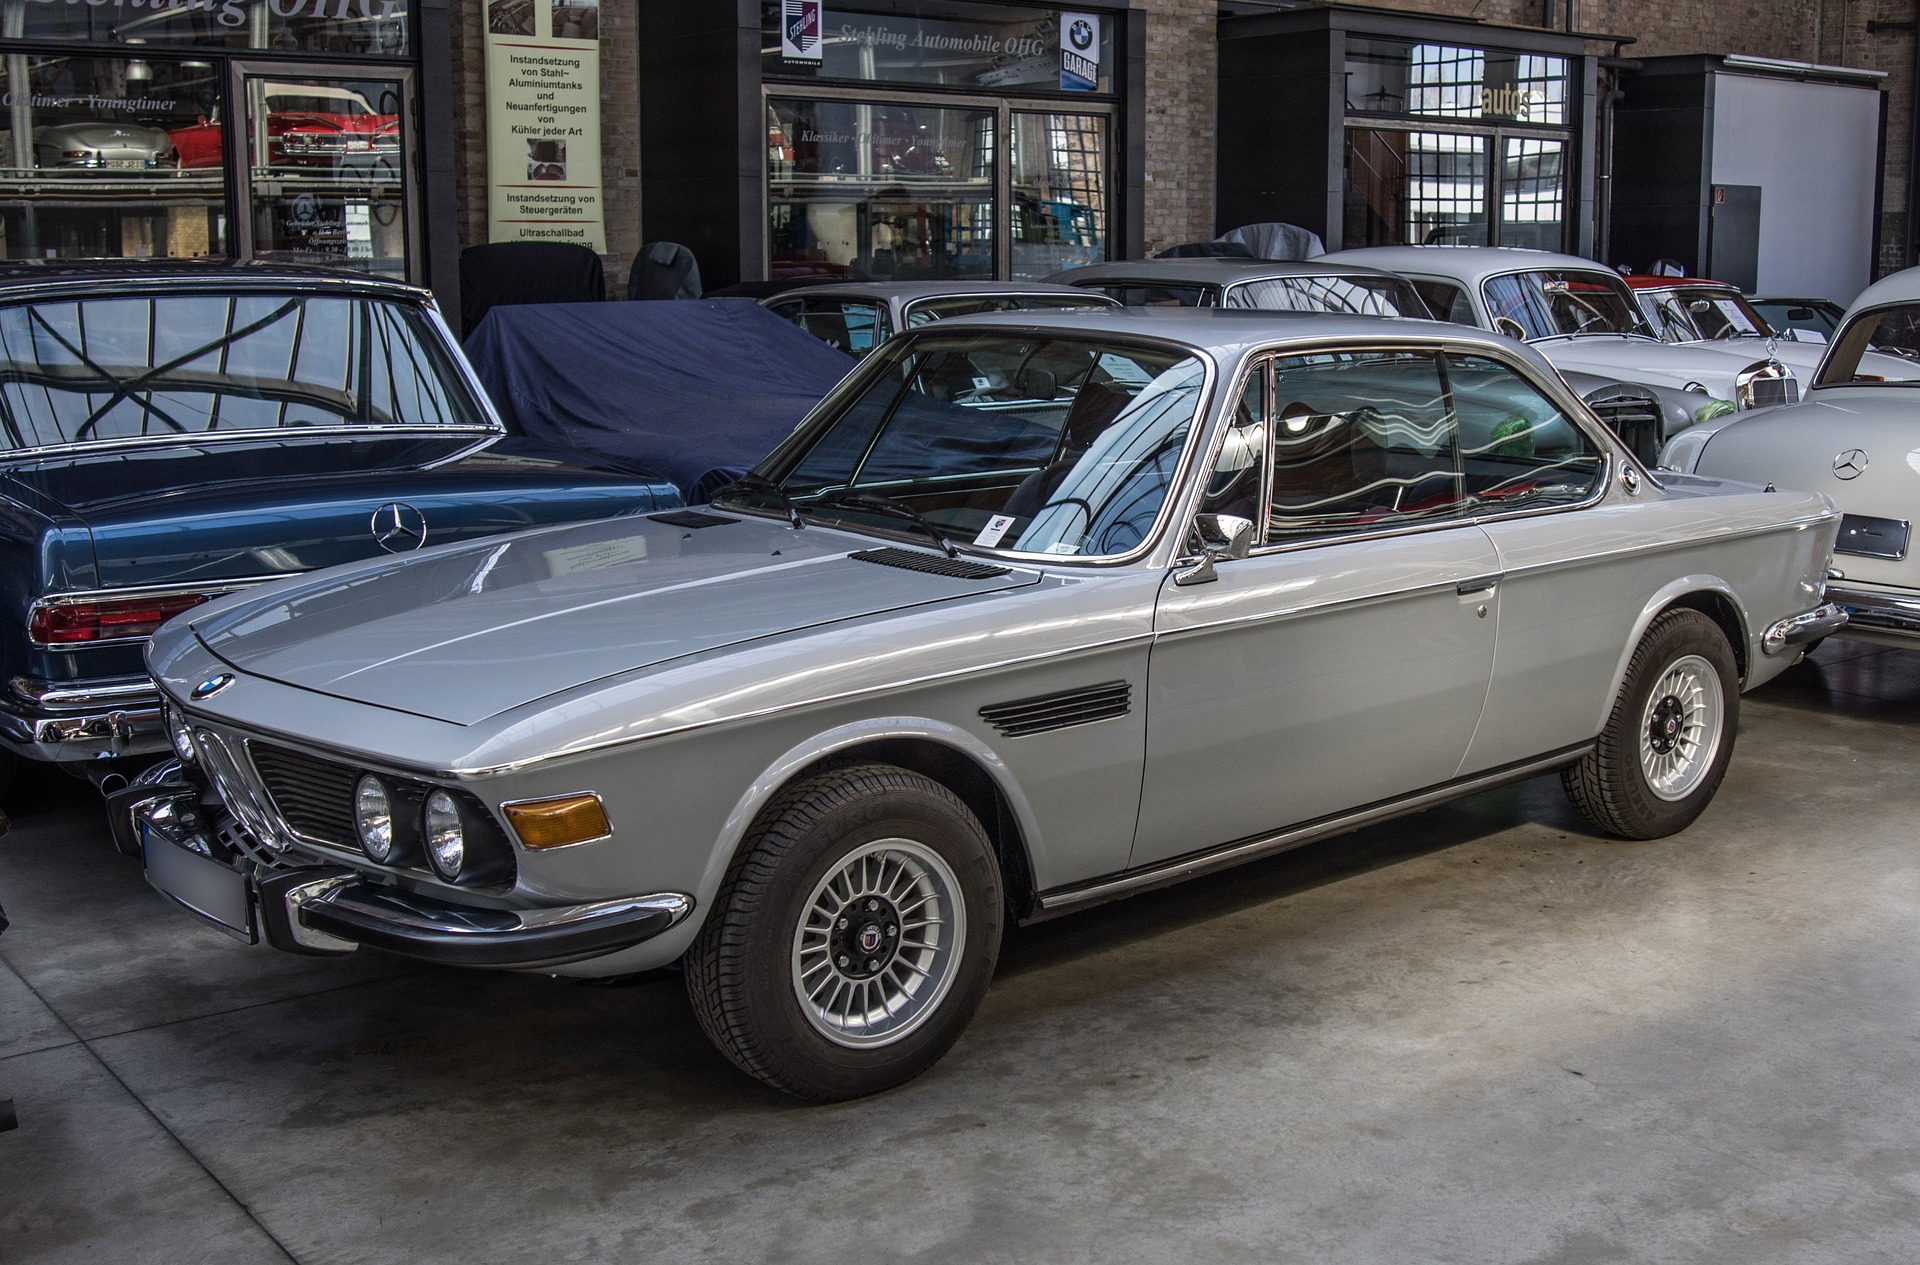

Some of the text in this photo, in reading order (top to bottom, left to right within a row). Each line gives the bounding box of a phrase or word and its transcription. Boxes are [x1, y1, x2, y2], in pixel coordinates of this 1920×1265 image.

[790, 8, 816, 41] STEHLING
[841, 24, 1045, 57] Stehling Automobile OHG
[510, 55, 580, 68] Instandsetzung
[1063, 51, 1097, 83] GARAGE
[521, 69, 538, 77] von
[508, 78, 583, 90] Aluminiumtanks
[2, 92, 176, 112] Otimer Youngtimer
[536, 92, 554, 101] und
[1482, 82, 1530, 117] autos
[506, 102, 587, 115] Neuanfertigungen
[537, 116, 554, 124] von
[511, 125, 583, 137] Kühler jeder Art
[801, 130, 850, 144] Klassiker
[506, 193, 595, 205] Instandsetzung von
[519, 205, 583, 216] Steuergeräten
[519, 228, 584, 238] Ultraschallbad
